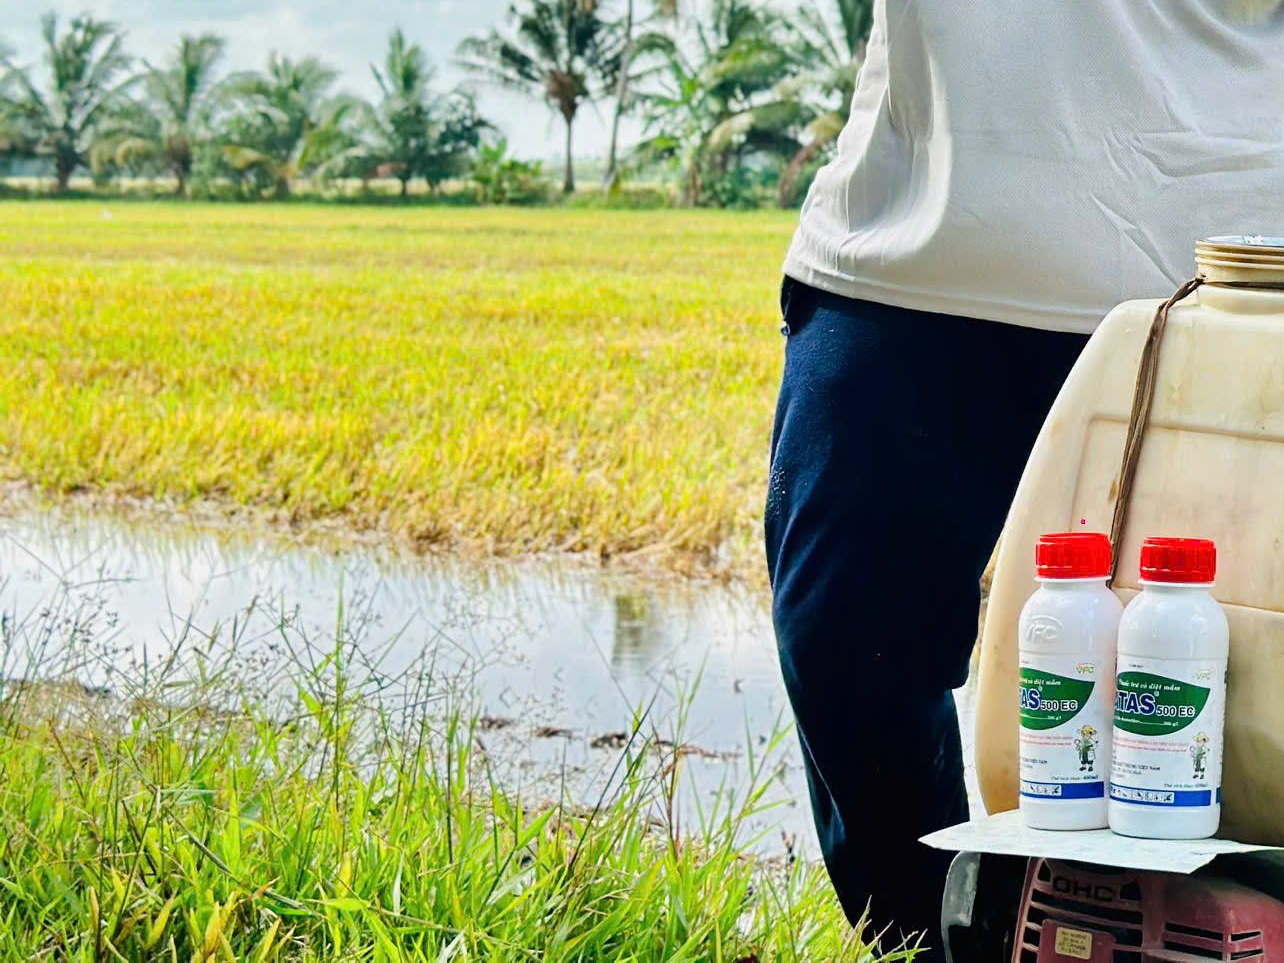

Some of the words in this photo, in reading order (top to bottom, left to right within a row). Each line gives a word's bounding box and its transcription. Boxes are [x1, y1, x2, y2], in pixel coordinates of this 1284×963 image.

[1040, 699, 1059, 711] 500
[1060, 700, 1078, 711] EC
[1156, 704, 1177, 717] 500
[1178, 705, 1196, 718] EC
[1053, 876, 1114, 903] OHC
